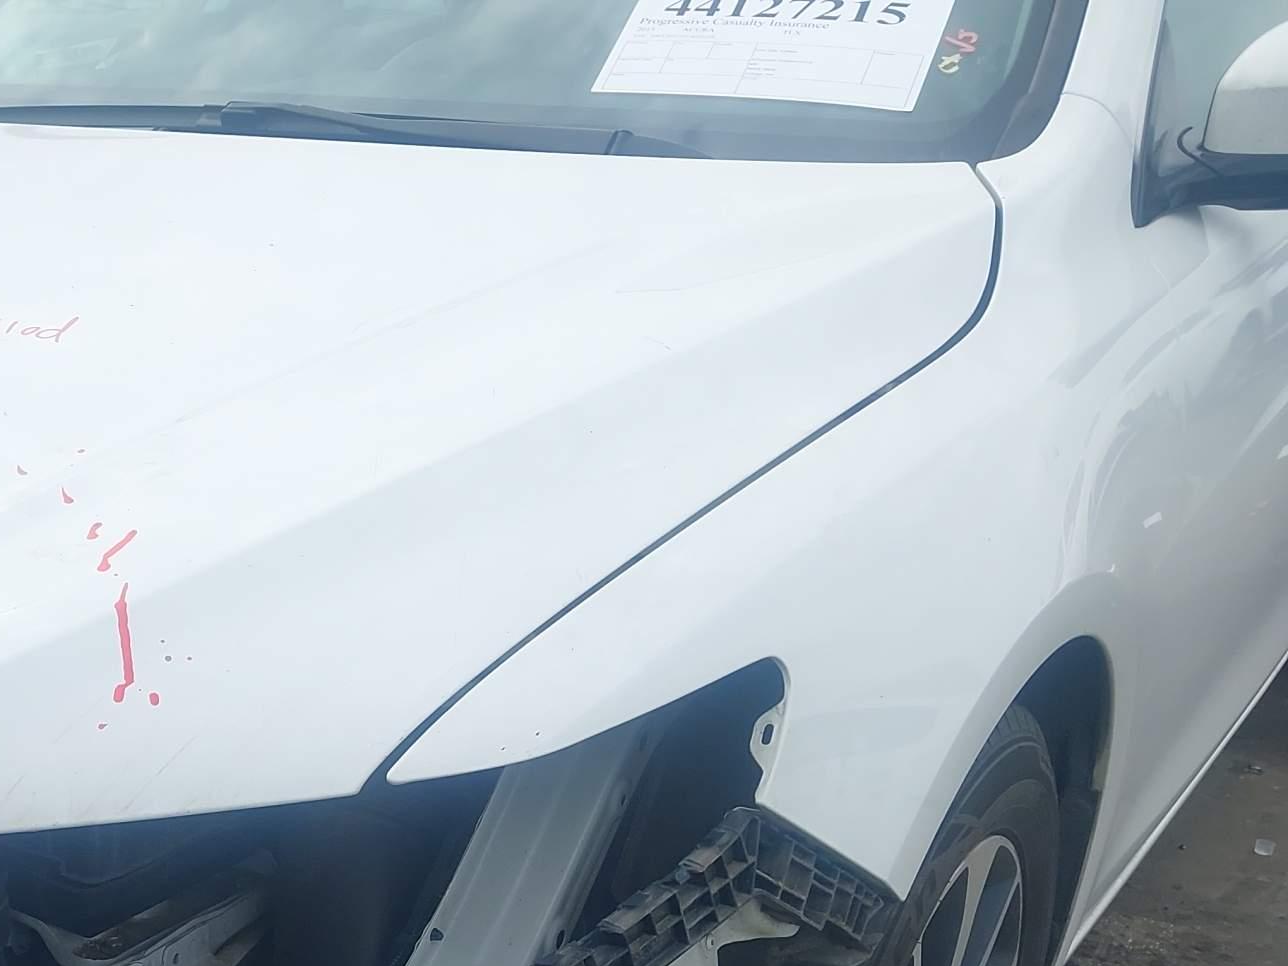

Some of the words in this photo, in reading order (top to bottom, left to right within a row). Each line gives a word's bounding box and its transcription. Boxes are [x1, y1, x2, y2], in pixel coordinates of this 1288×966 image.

[664, 0, 911, 25] 44127215
[639, 17, 710, 26] Progressive
[712, 18, 763, 27] Casualty
[769, 19, 831, 29] Insurance
